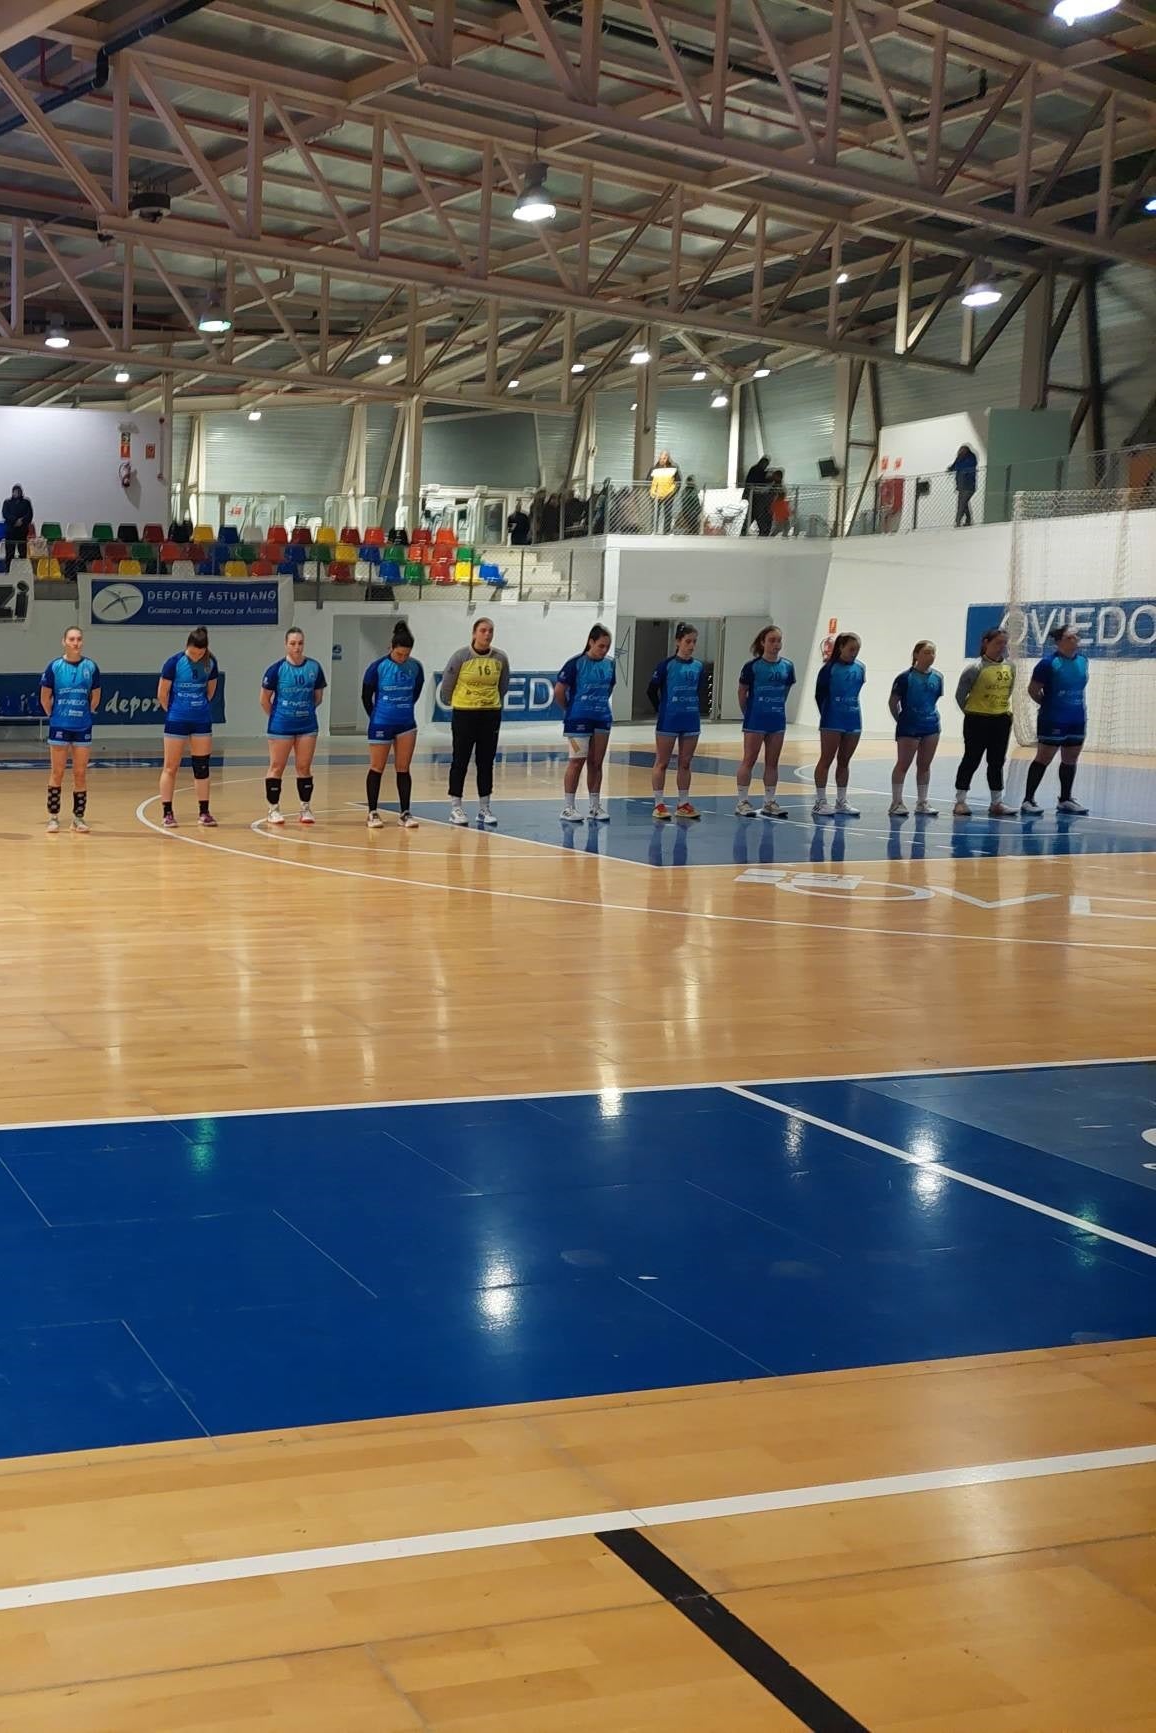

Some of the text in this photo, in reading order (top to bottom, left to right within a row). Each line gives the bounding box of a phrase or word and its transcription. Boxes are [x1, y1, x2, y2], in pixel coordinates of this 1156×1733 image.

[147, 590, 276, 602] DEPORTE ASTURIANO
[478, 664, 492, 677] 16
[996, 670, 1010, 681] 33
[71, 672, 77, 683] 7
